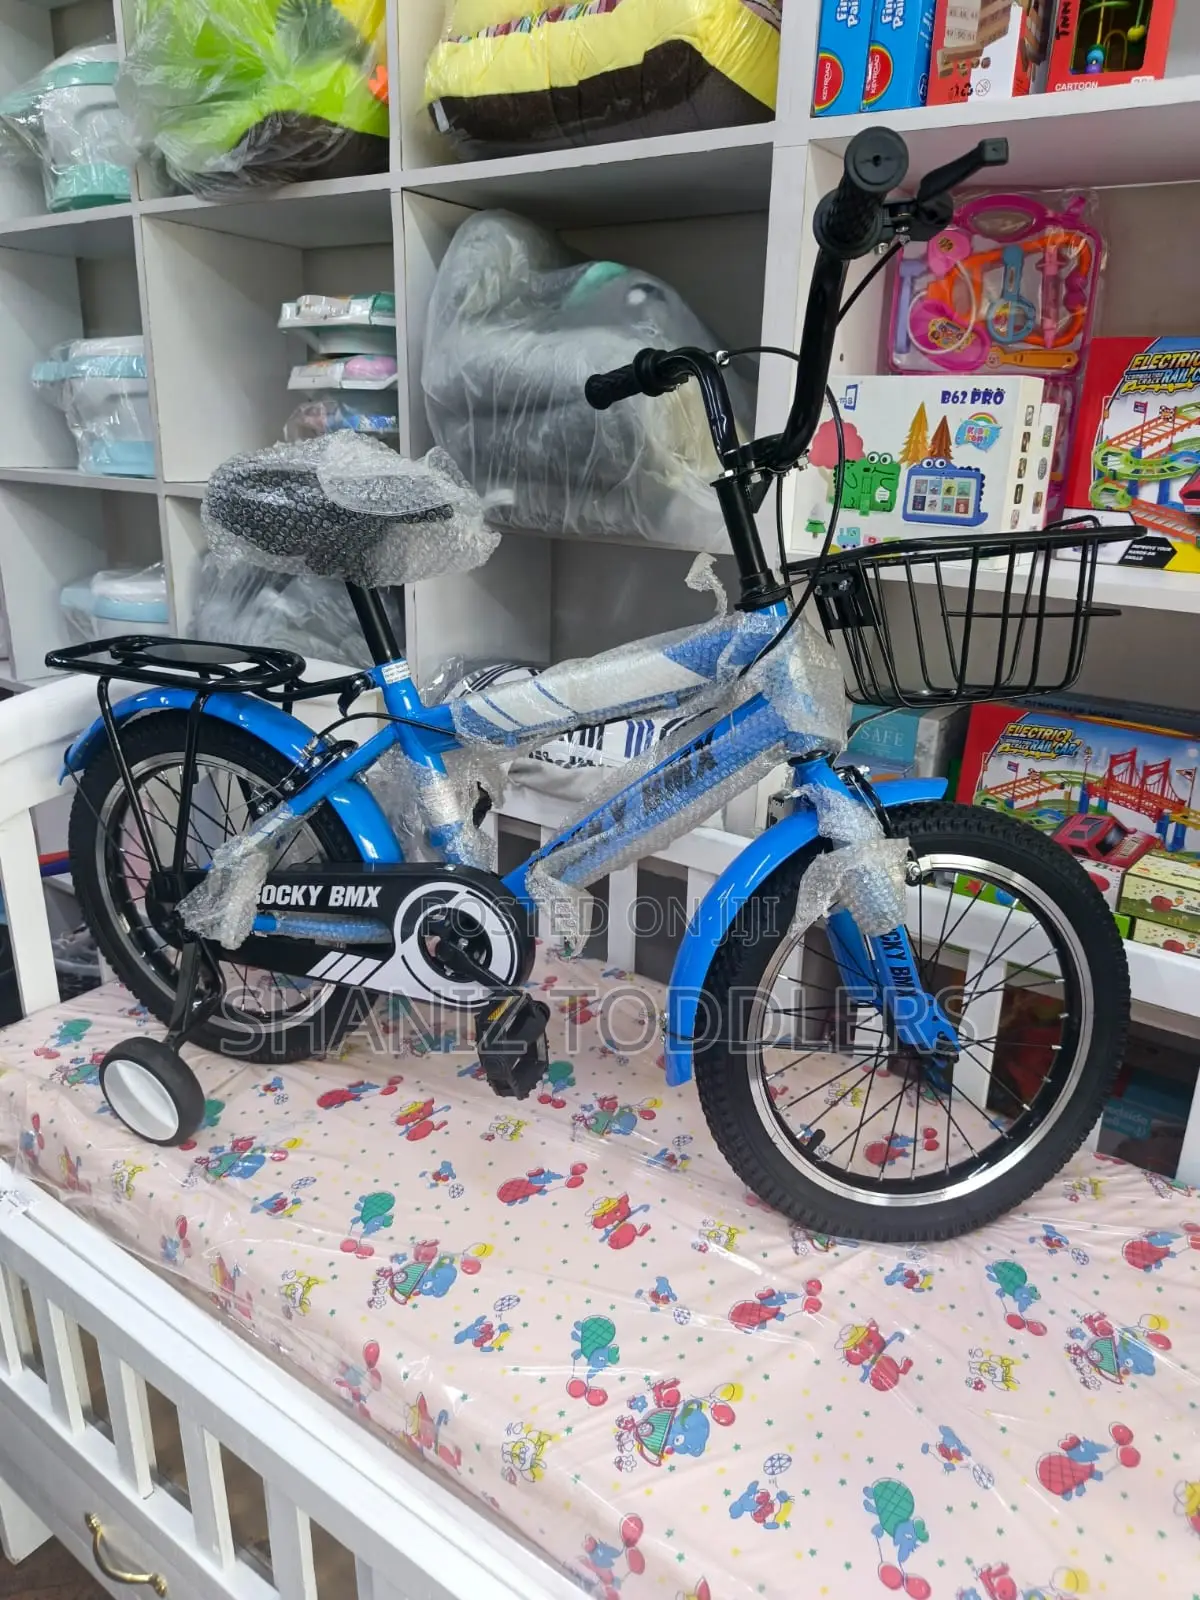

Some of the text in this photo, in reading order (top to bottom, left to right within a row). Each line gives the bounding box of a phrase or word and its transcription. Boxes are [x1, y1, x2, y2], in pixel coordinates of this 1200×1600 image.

[822, 62, 832, 101] KEYROAD
[870, 55, 881, 94] KEYROAD
[1055, 81, 1098, 92] CARTOON
[941, 388, 1005, 405] B62 PRO
[860, 725, 904, 747] SAFE
[1006, 724, 1067, 742] ELECTRIC
[328, 886, 383, 908] BMX
[889, 967, 918, 997] BMX
